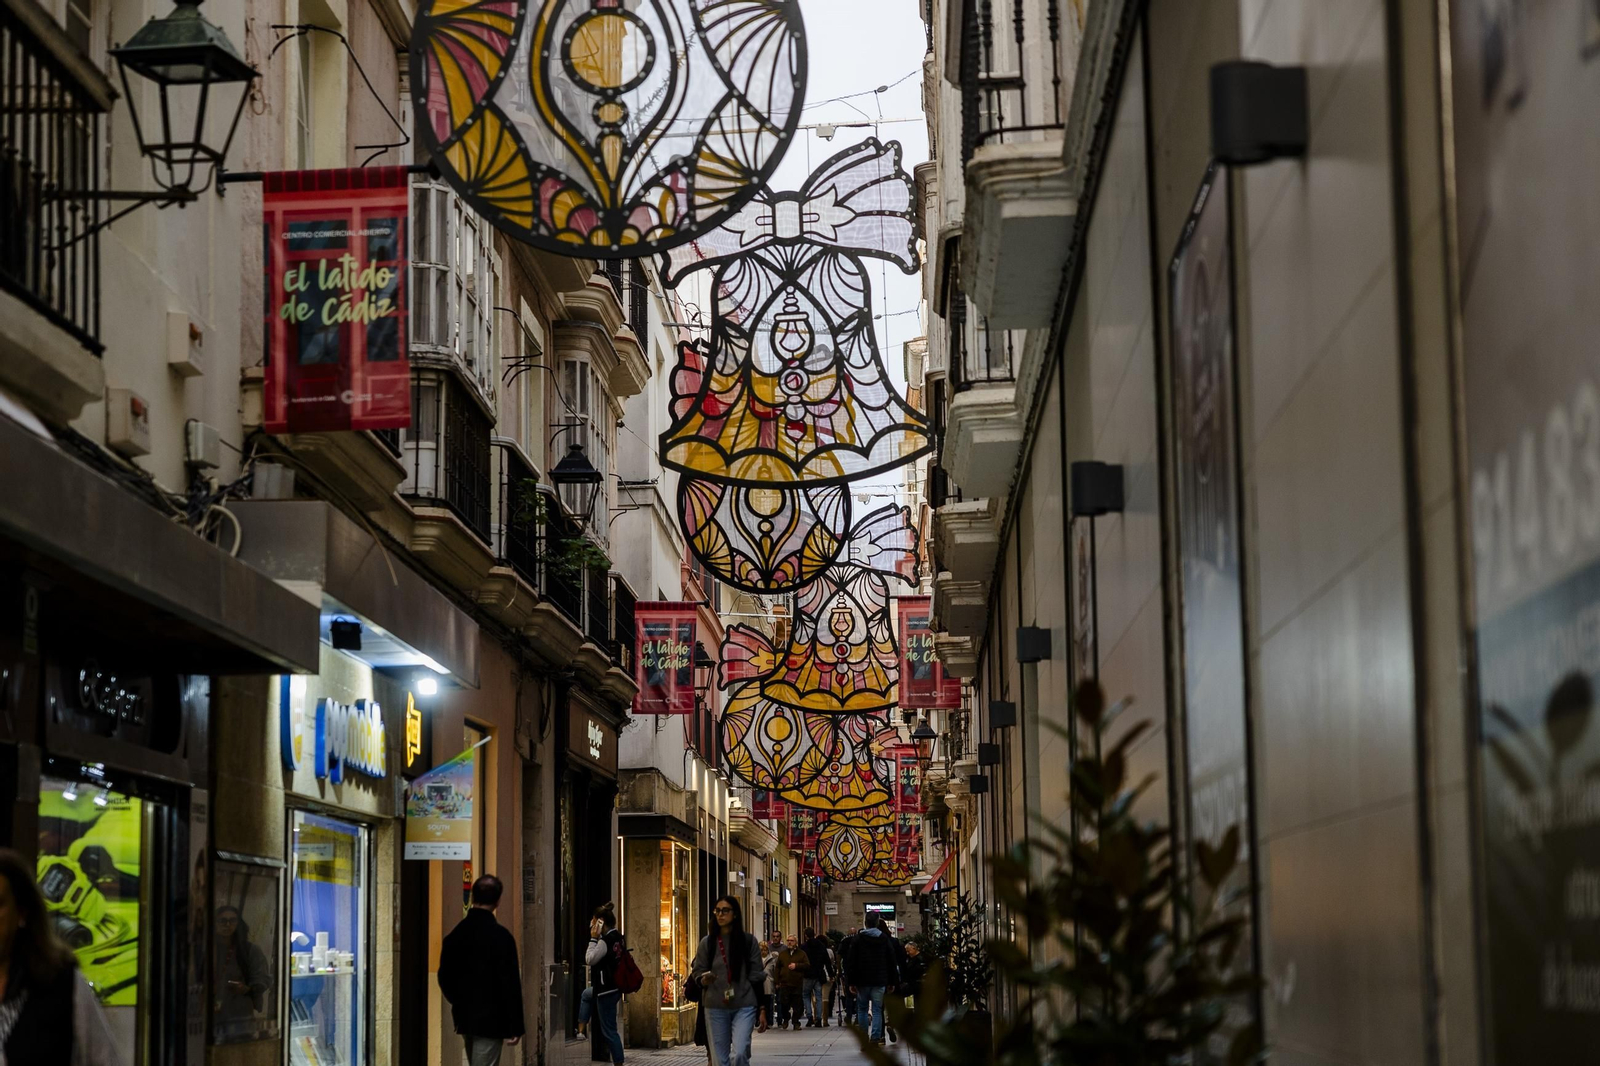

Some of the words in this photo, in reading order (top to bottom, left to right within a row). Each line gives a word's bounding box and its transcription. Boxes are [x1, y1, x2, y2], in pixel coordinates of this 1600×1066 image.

[281, 231, 313, 240] CENTRO
[314, 229, 356, 239] COMERCIAL
[358, 227, 391, 237] ABIERTO
[283, 262, 311, 293] El
[319, 252, 395, 293] latido
[280, 294, 315, 325] de
[321, 291, 396, 325] Cádiz
[642, 640, 653, 654] El
[657, 638, 690, 654] latido
[907, 634, 918, 648] El
[921, 633, 936, 648] lat
[640, 655, 655, 668] de
[657, 655, 690, 670] Cádiz
[905, 649, 920, 662] de
